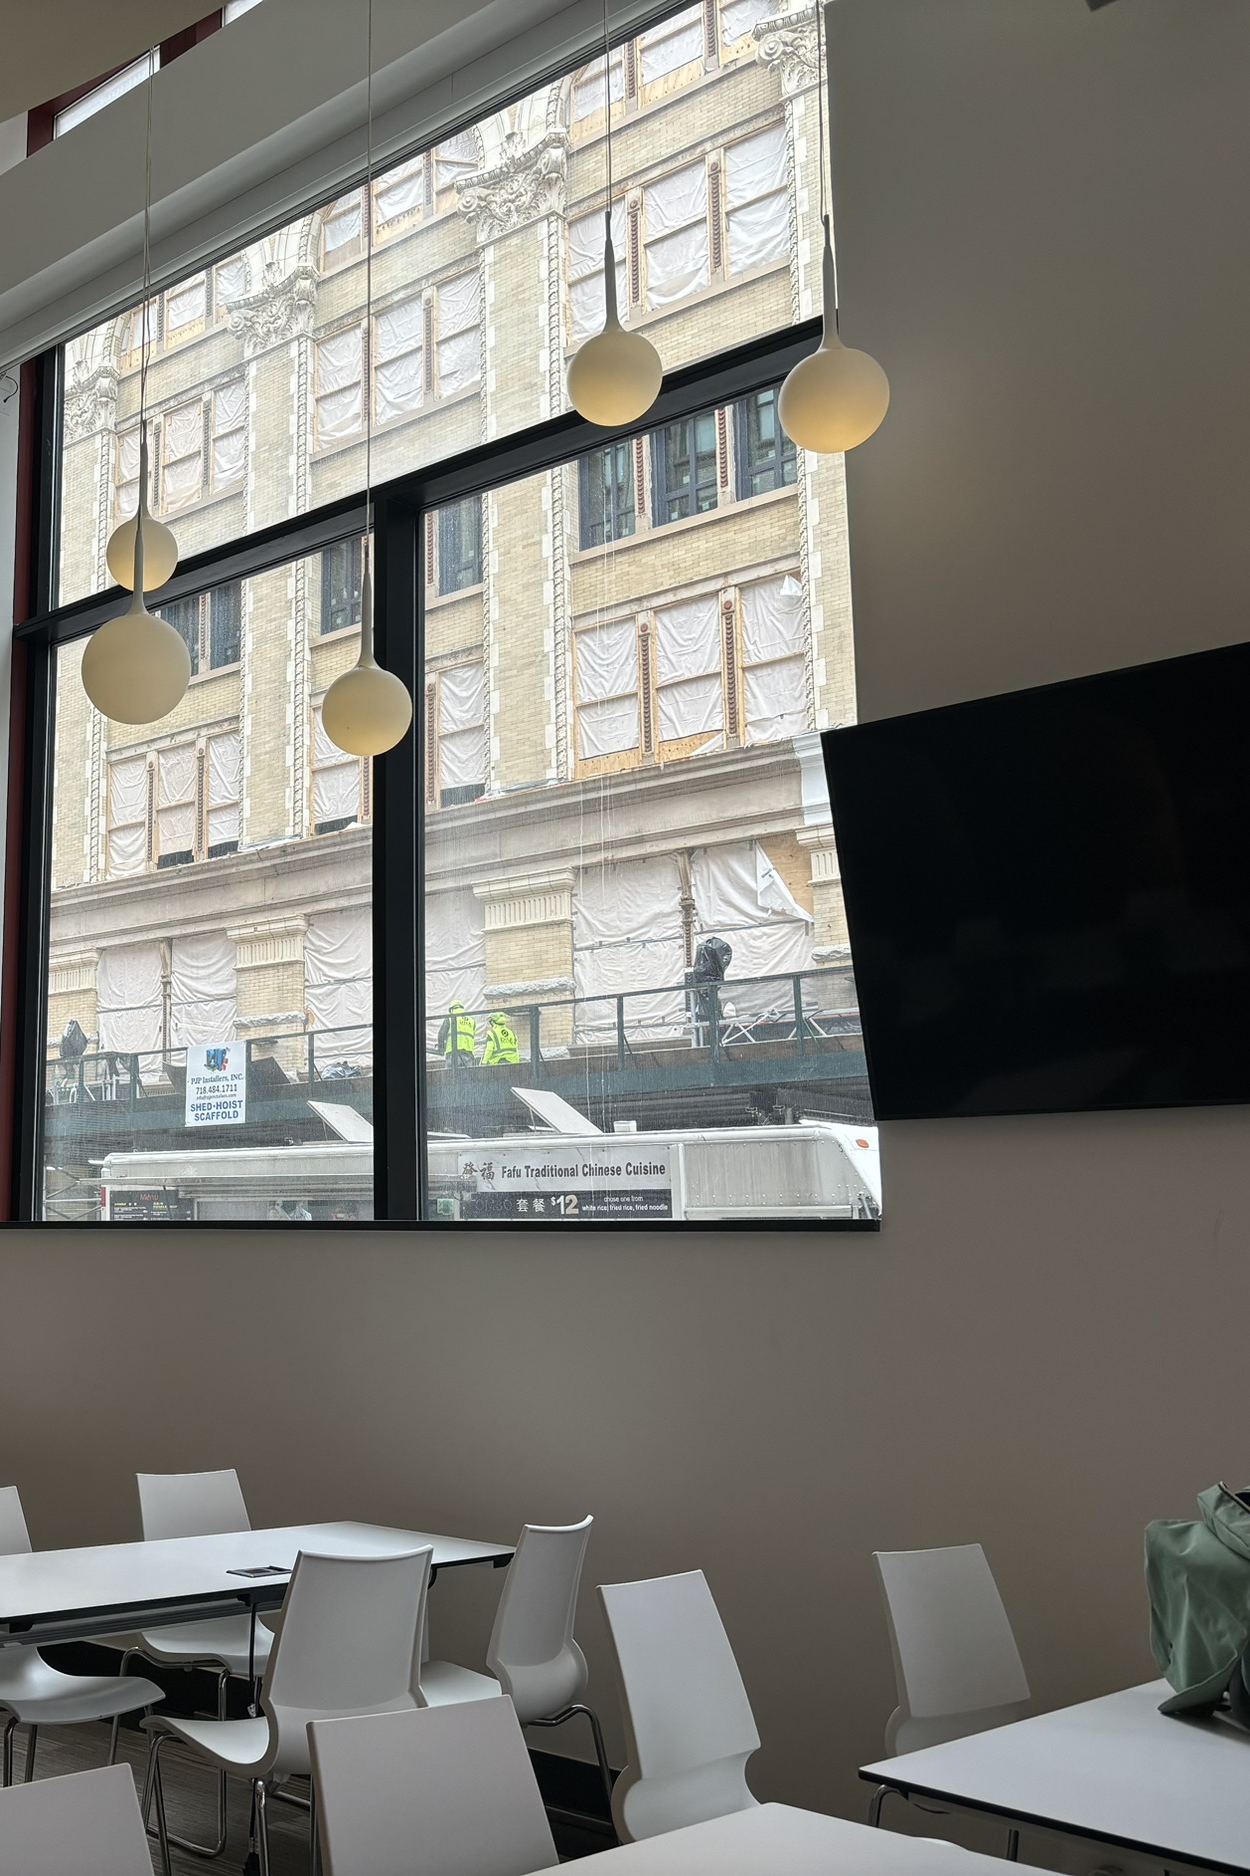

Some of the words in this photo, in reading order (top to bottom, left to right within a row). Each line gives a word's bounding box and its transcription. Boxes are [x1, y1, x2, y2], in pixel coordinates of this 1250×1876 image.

[191, 1077, 203, 1085] PJP
[194, 1110, 239, 1121] SCAFFOLD
[501, 1165, 522, 1179] Fafu
[524, 1164, 579, 1178] Traditional
[581, 1163, 622, 1177] Chinese
[625, 1162, 666, 1176] Cuisine
[550, 1194, 579, 1215] $12
[649, 1203, 668, 1211] noodle
